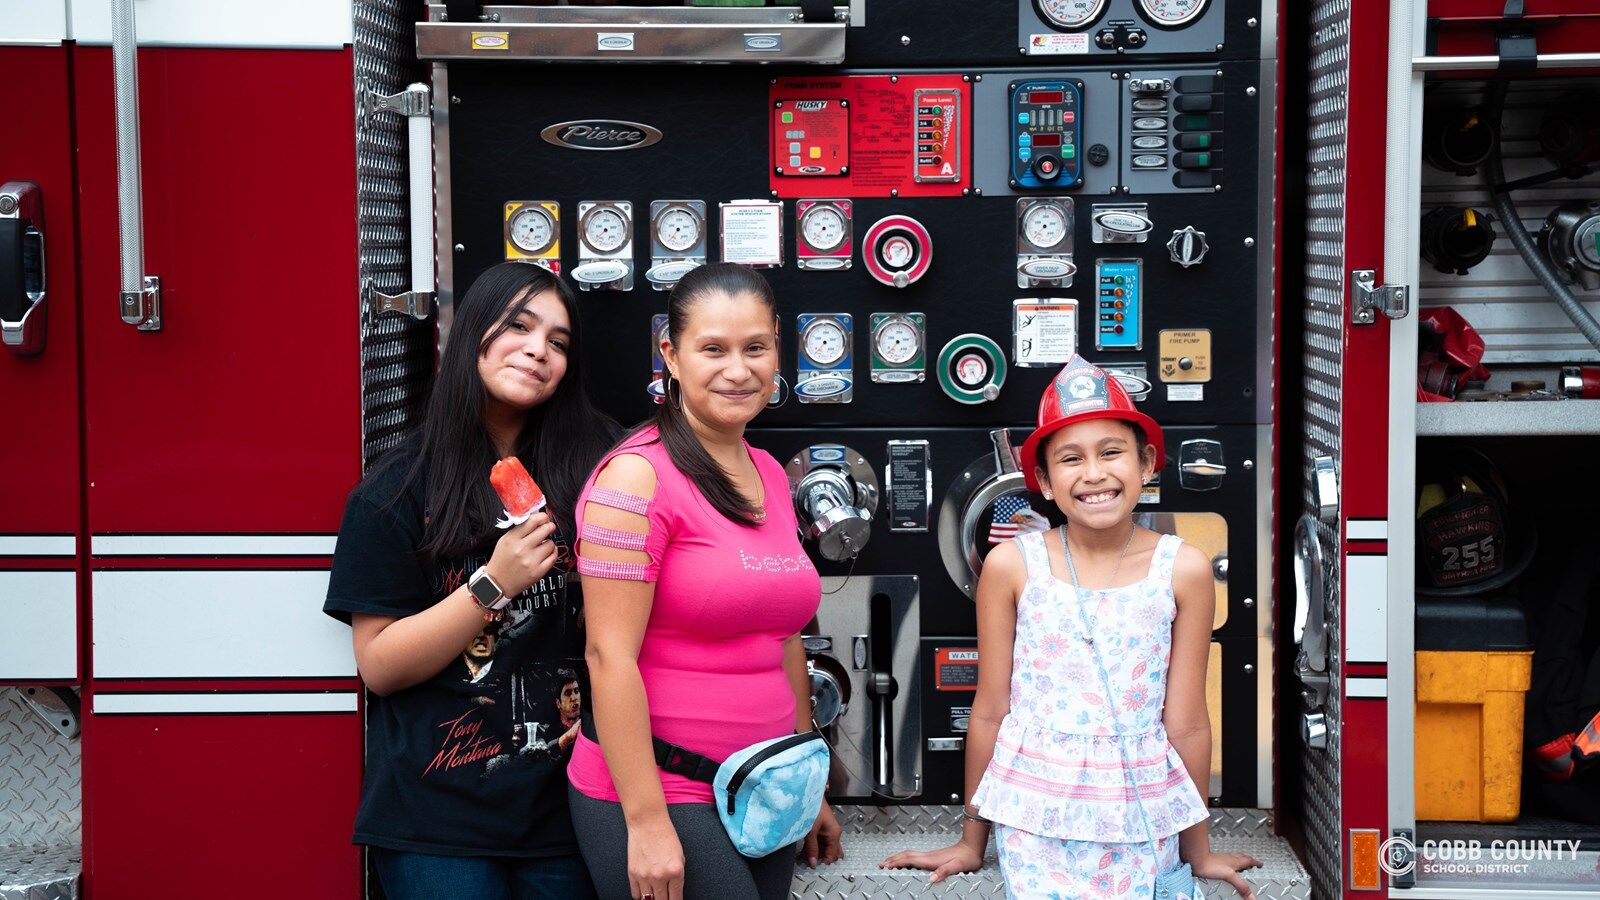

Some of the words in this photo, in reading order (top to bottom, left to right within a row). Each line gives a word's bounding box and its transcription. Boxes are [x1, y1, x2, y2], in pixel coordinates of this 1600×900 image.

[562, 125, 642, 142] Pierce
[941, 162, 953, 174] A
[1069, 400, 1104, 410] FIREFIGHTER
[1438, 521, 1491, 542] HAWKINS
[740, 549, 814, 572] bebe
[1442, 536, 1494, 570] 255
[518, 592, 558, 614] YOURS
[438, 707, 484, 750] Tony
[421, 736, 502, 779] Montana
